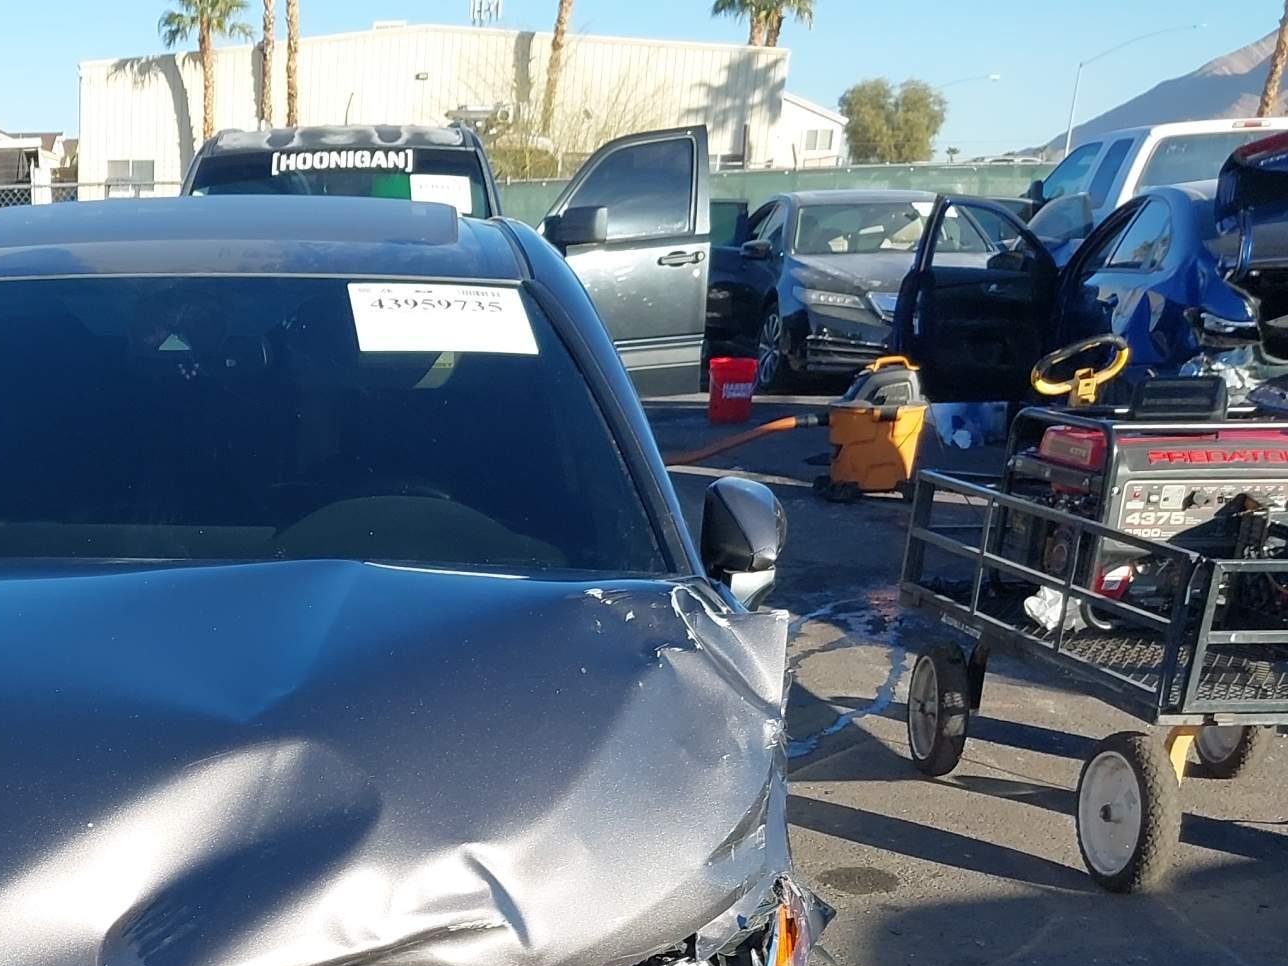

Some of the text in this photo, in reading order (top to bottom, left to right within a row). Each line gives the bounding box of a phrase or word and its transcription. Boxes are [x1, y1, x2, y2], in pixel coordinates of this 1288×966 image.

[369, 297, 503, 313] 43959735
[1148, 449, 1288, 464] PREDATO
[1125, 511, 1185, 525] 4375
